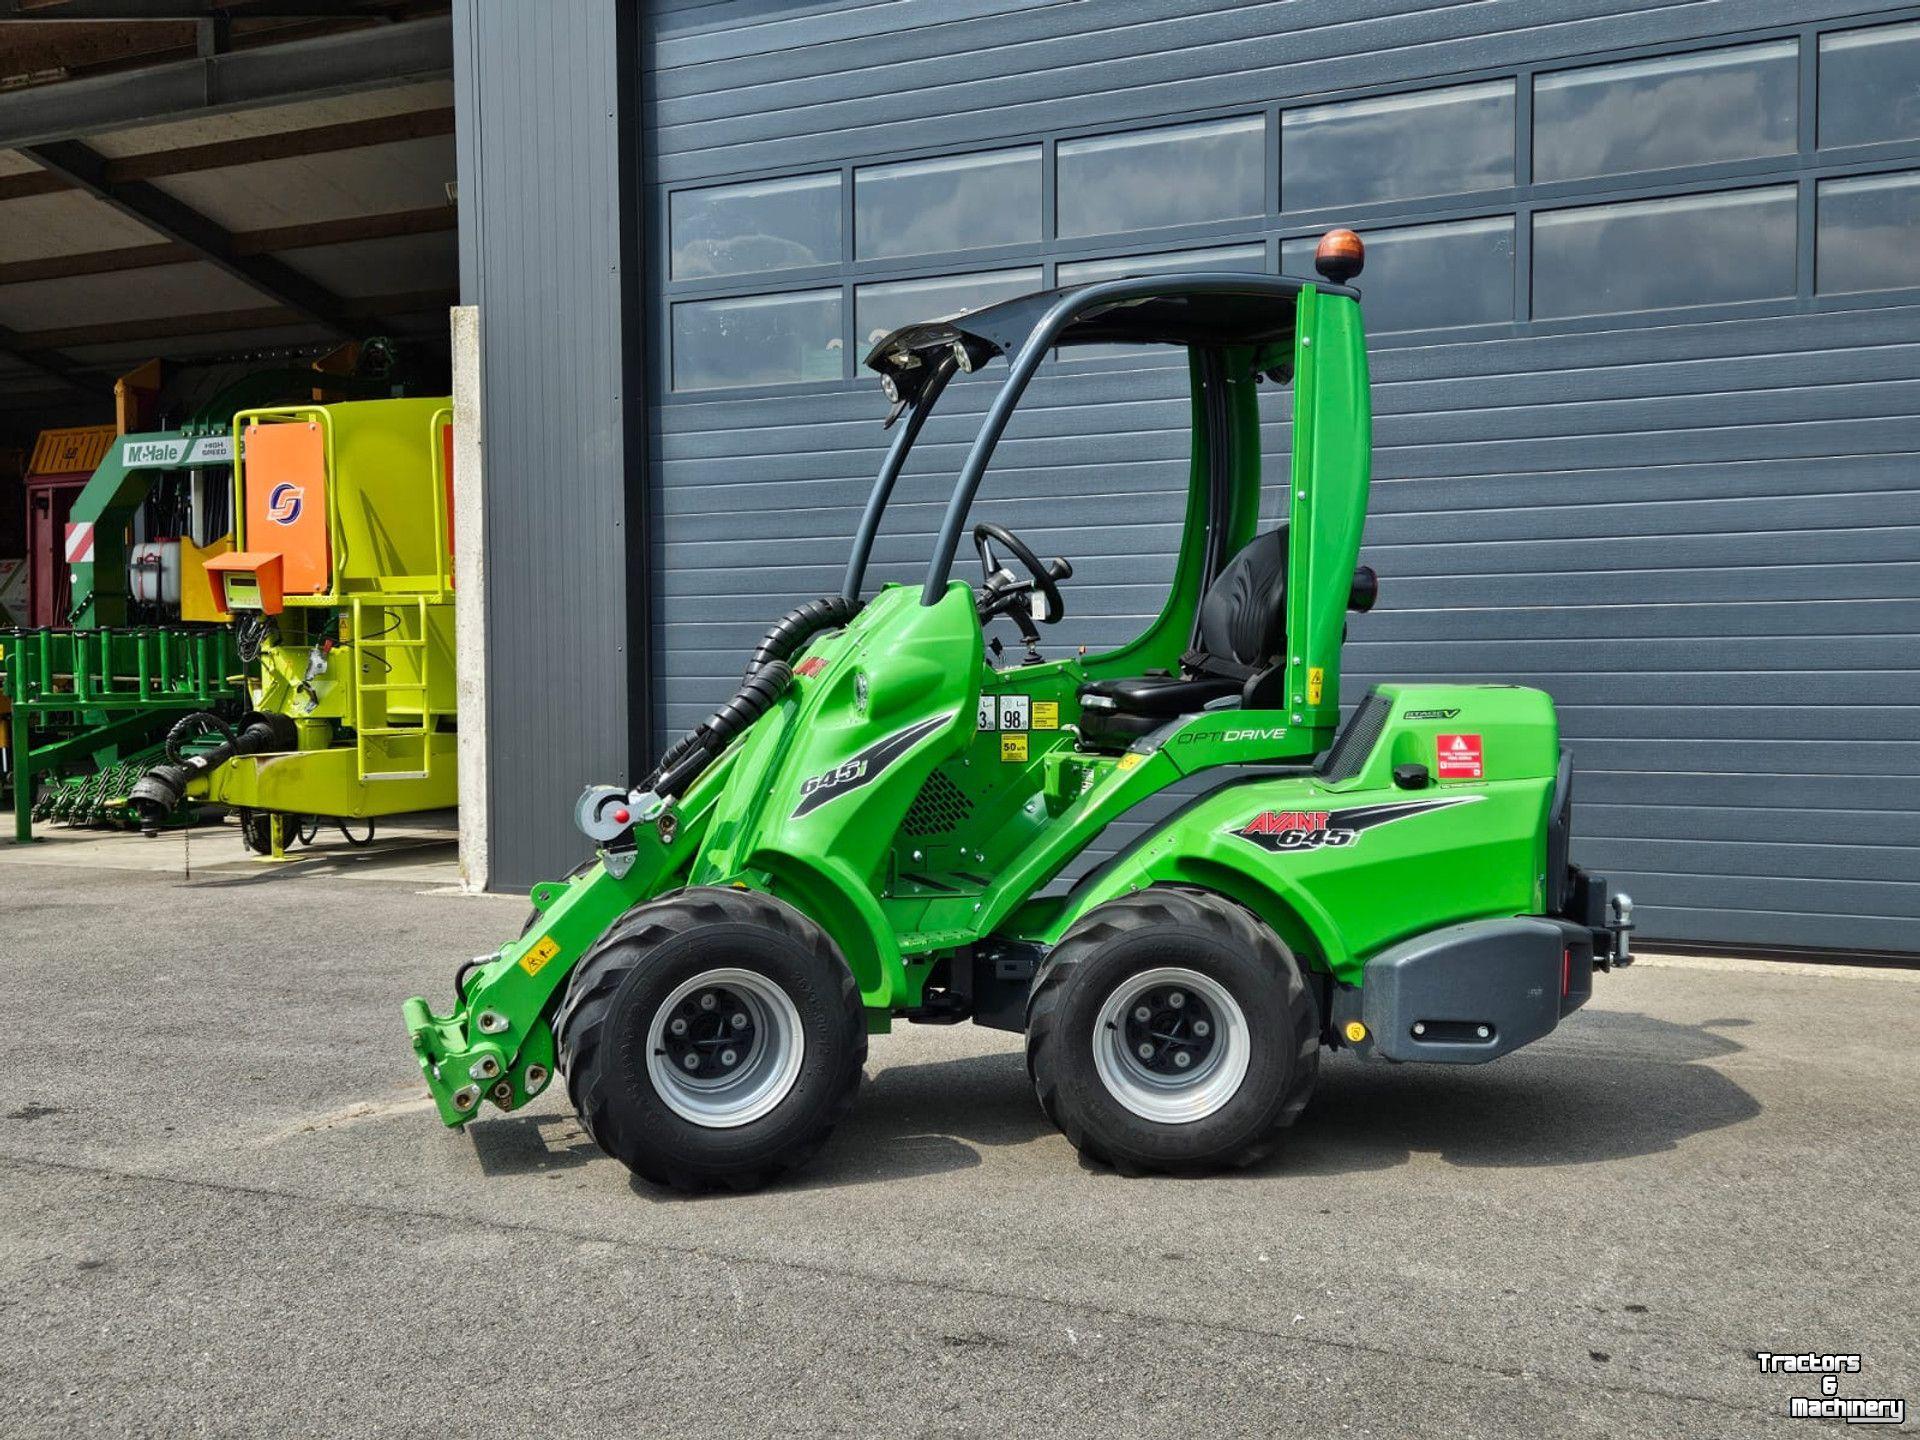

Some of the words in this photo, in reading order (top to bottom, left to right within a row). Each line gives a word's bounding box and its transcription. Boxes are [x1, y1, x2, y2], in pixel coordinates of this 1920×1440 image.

[1004, 711, 1020, 728] 98
[1178, 728, 1287, 744] OPTIDRIVE
[1241, 810, 1330, 835] AVANT
